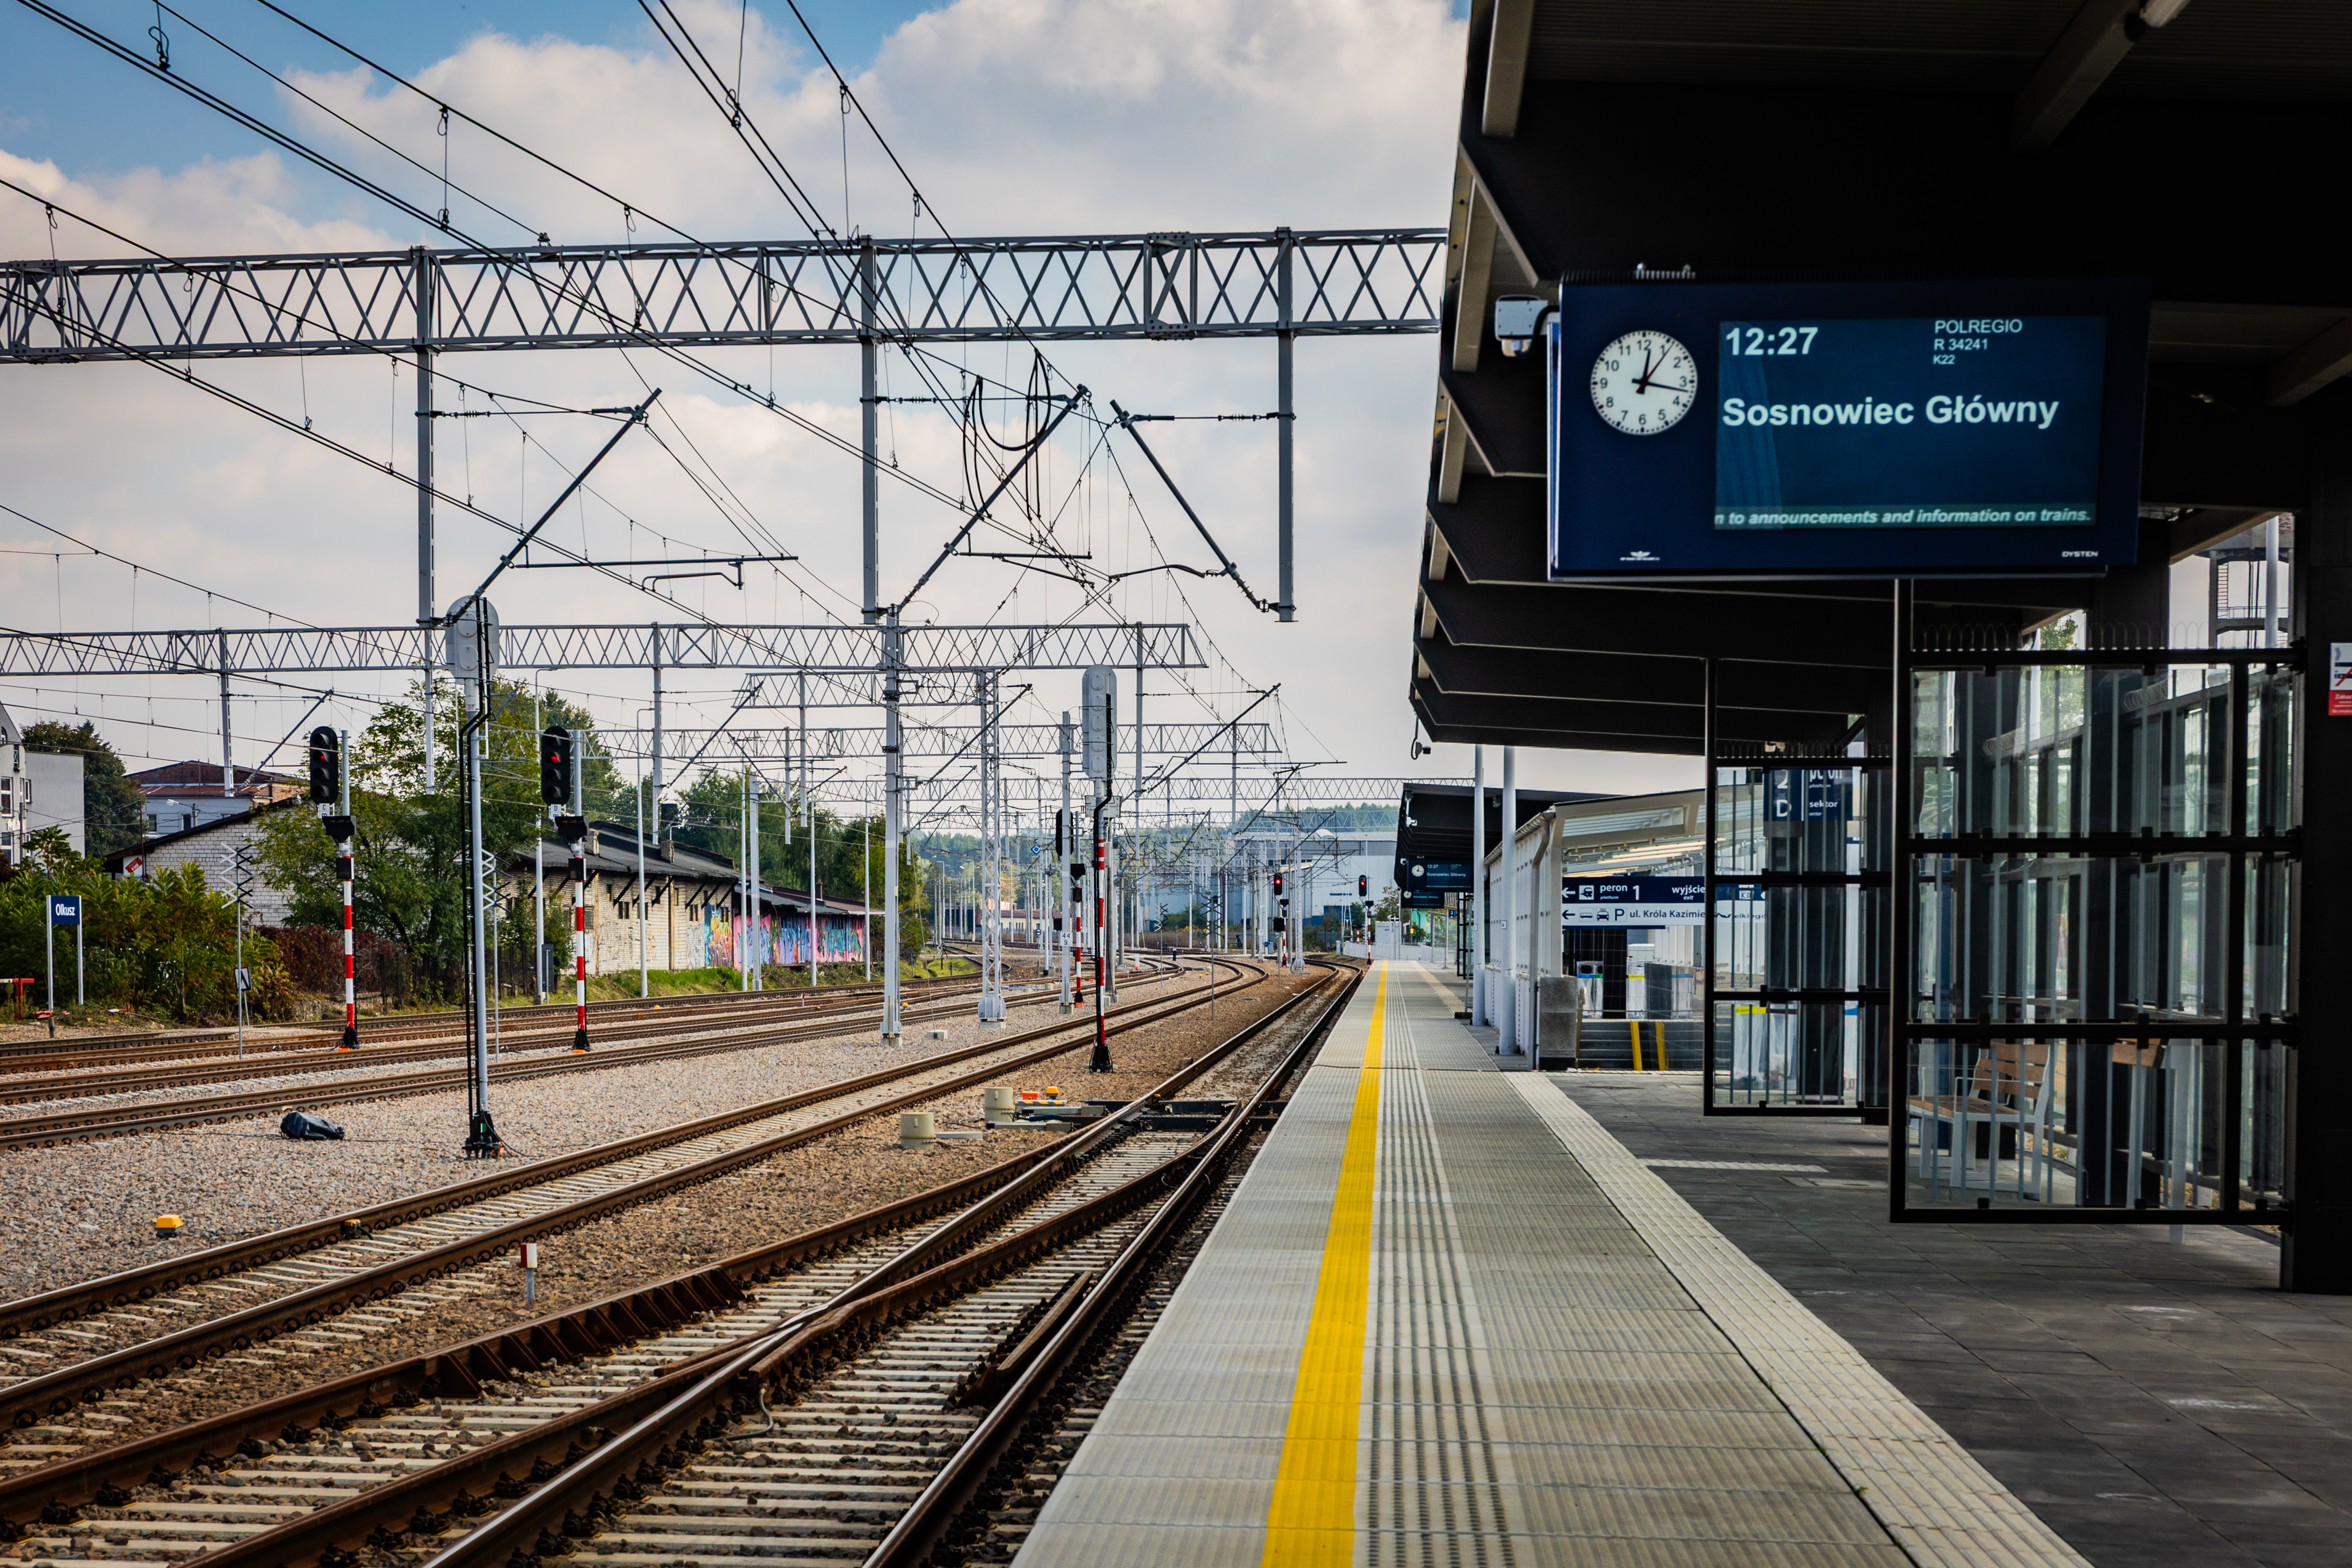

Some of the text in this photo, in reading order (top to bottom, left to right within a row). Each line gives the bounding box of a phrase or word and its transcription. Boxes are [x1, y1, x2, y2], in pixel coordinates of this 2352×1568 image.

[1934, 318, 2023, 334] POLREGIO
[1637, 339, 1652, 351] 12
[1726, 326, 1818, 355] 12:27
[1934, 338, 1988, 351] R 34241
[1618, 345, 1631, 355] 11
[1660, 345, 1666, 354] 1
[1673, 357, 1681, 368] 2
[1933, 354, 1956, 364] K22
[1604, 360, 1620, 371] 10
[1600, 377, 1608, 389] 9
[1679, 376, 1687, 387] 3
[1606, 396, 1614, 408] 8
[1672, 395, 1680, 406] 4
[1621, 410, 1628, 421] 7
[1658, 409, 1666, 420] 5
[1722, 394, 2060, 429] Sosnowiec Główny
[1638, 414, 1647, 425] 6
[1728, 512, 1745, 525] to
[1748, 510, 1877, 525] announcements
[1881, 509, 1914, 524] and
[1916, 508, 2011, 523] information
[2015, 510, 2036, 522] on
[2040, 508, 2091, 521] trains.
[1809, 770, 1843, 782] peon
[1776, 799, 1792, 817] D
[1600, 885, 1640, 900] peron 1
[1672, 886, 1705, 895] wyjście
[56, 904, 75, 916] Olkusz
[1615, 909, 1625, 921] P
